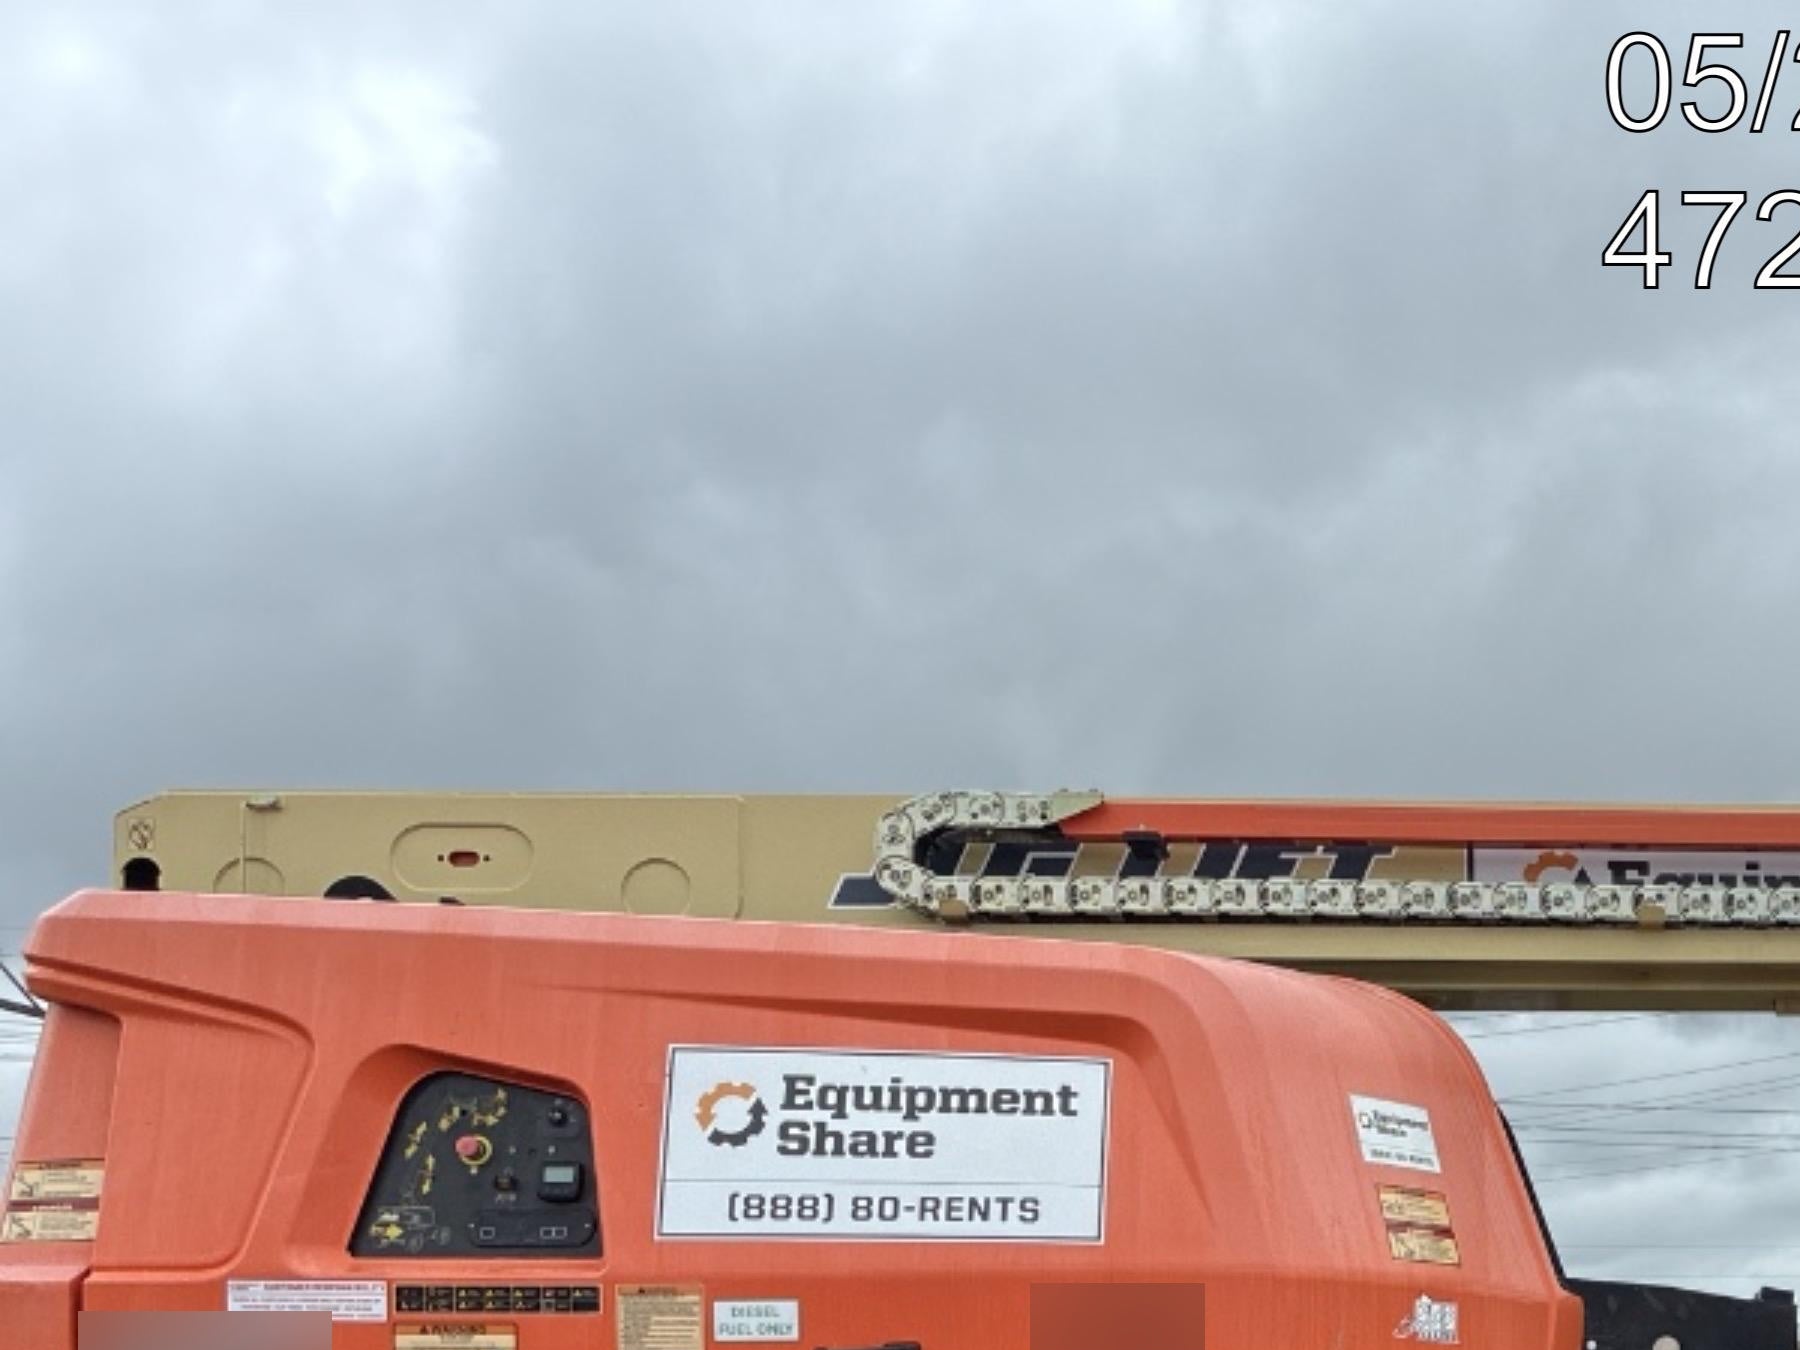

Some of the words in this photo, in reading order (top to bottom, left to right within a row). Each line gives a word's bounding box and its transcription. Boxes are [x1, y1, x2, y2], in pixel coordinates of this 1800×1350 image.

[779, 1074, 1079, 1121] Equipment
[776, 1119, 937, 1159] Share
[728, 1192, 834, 1223] (888)
[851, 1195, 1041, 1224] 80-RENTS
[730, 1305, 781, 1319] DIESEL
[718, 1322, 754, 1337] FUEL
[756, 1322, 794, 1337] ONLY
